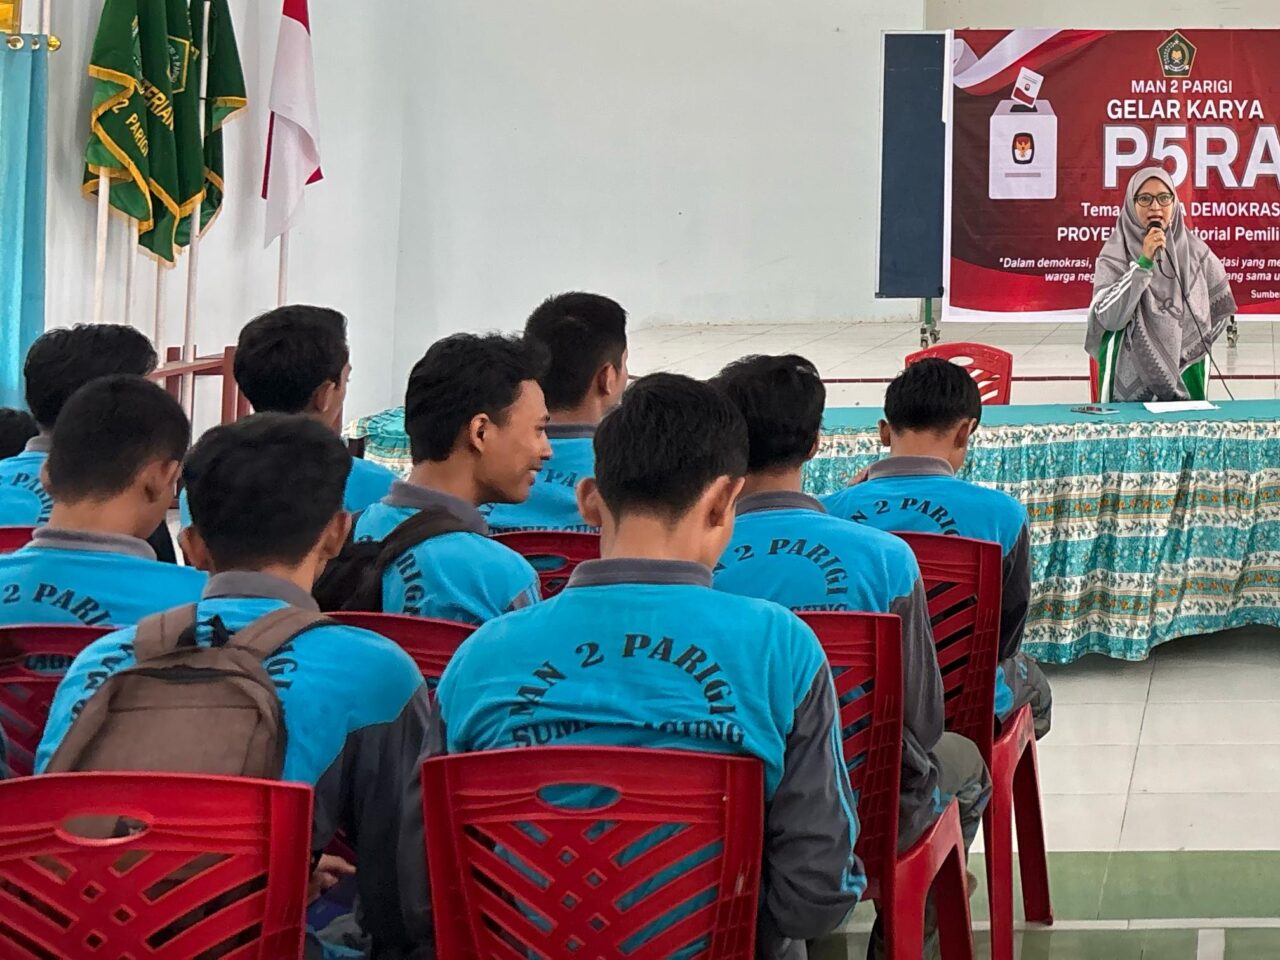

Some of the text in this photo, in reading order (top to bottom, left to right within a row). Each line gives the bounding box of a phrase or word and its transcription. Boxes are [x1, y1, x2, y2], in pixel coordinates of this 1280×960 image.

[1131, 80, 1233, 93] MAN 2 PARIGI
[111, 98, 129, 114] 2
[1107, 99, 1264, 119] GELAR KARYA
[1081, 203, 1120, 217] Tema
[1057, 227, 1115, 241] PROYE
[1037, 257, 1093, 270] demokrasi,
[1241, 259, 1265, 269] yang
[1045, 273, 1075, 282] warga
[1246, 273, 1272, 281] sama
[875, 500, 891, 515] 2
[734, 538, 848, 596] 2 PARIGI
[3, 582, 114, 627] 2 PARI
[509, 633, 737, 717] MAN 2 PARIGI
